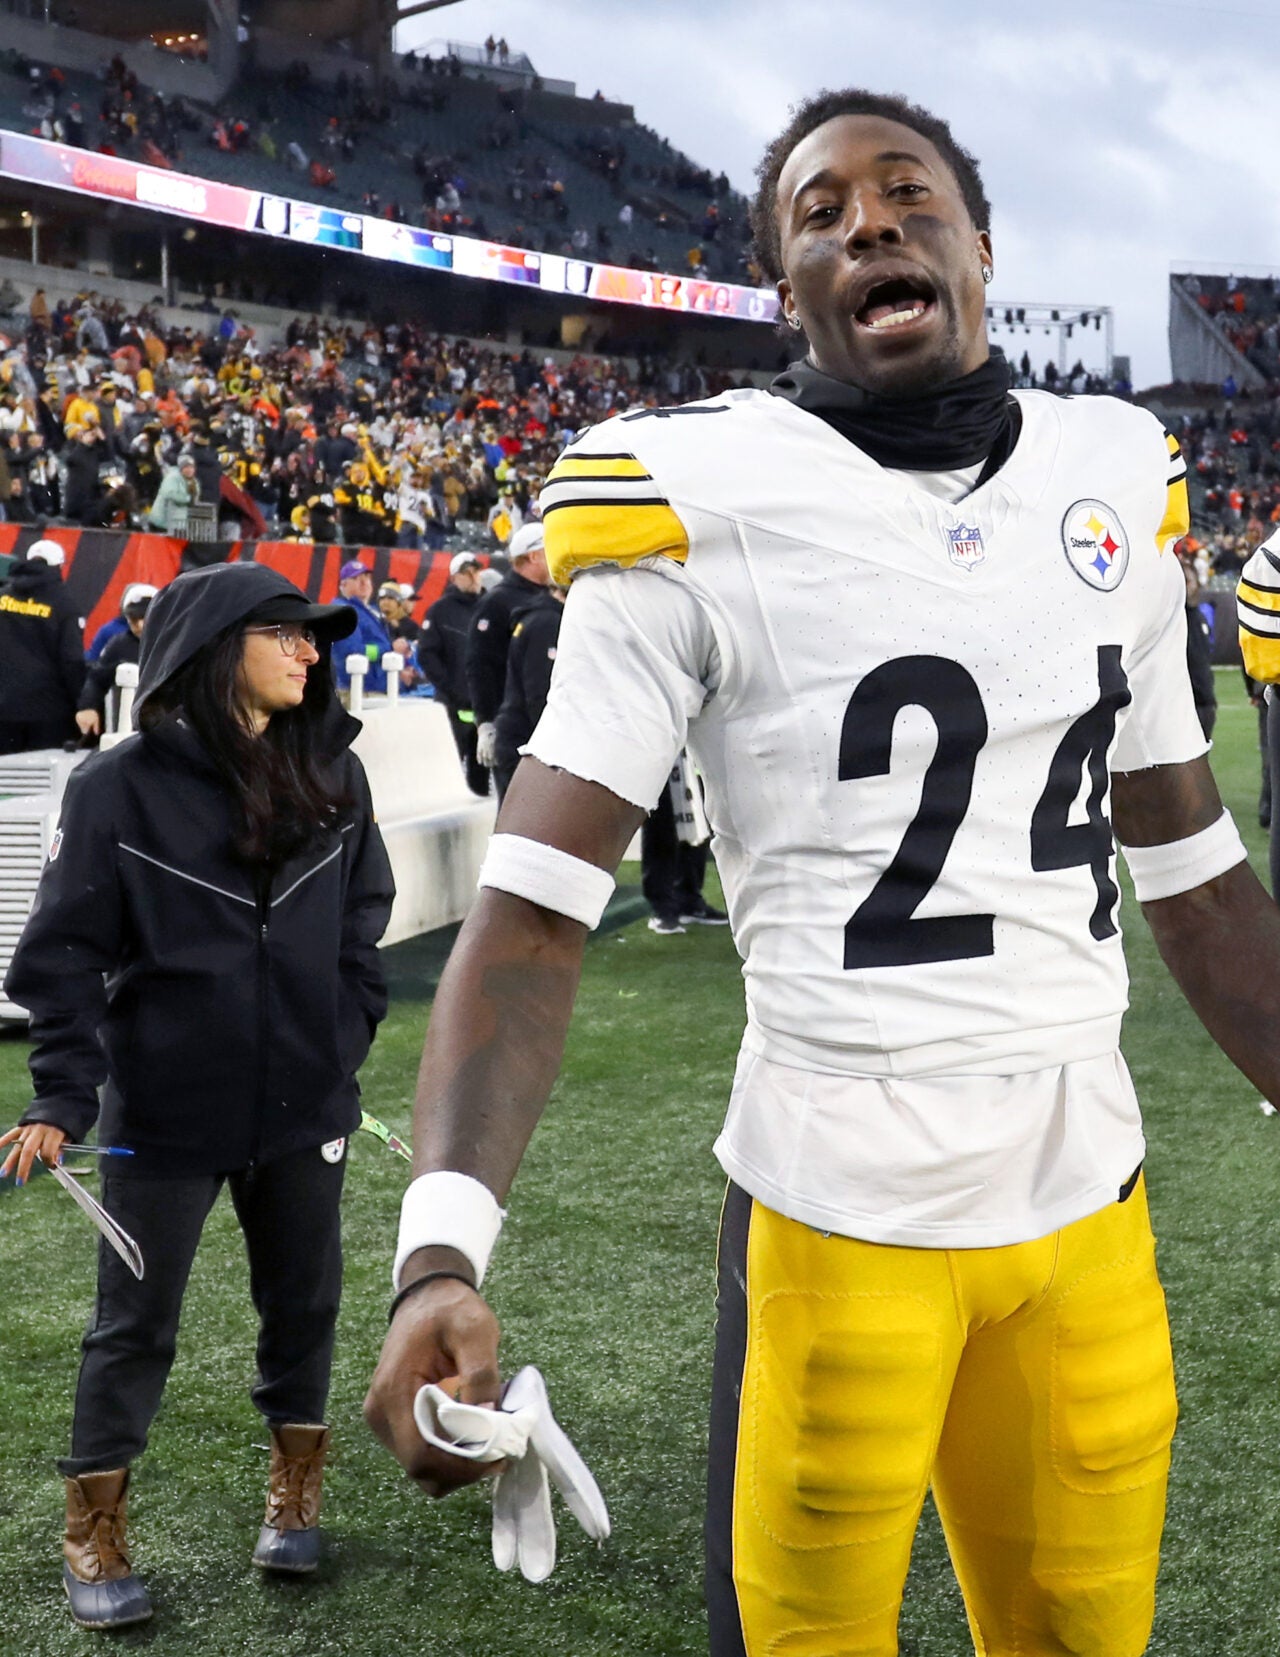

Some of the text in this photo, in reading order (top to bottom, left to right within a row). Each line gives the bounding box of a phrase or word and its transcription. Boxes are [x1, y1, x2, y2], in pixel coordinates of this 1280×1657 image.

[954, 541, 981, 557] NFL
[1070, 536, 1097, 549] Steelers
[838, 644, 1132, 970] 24
